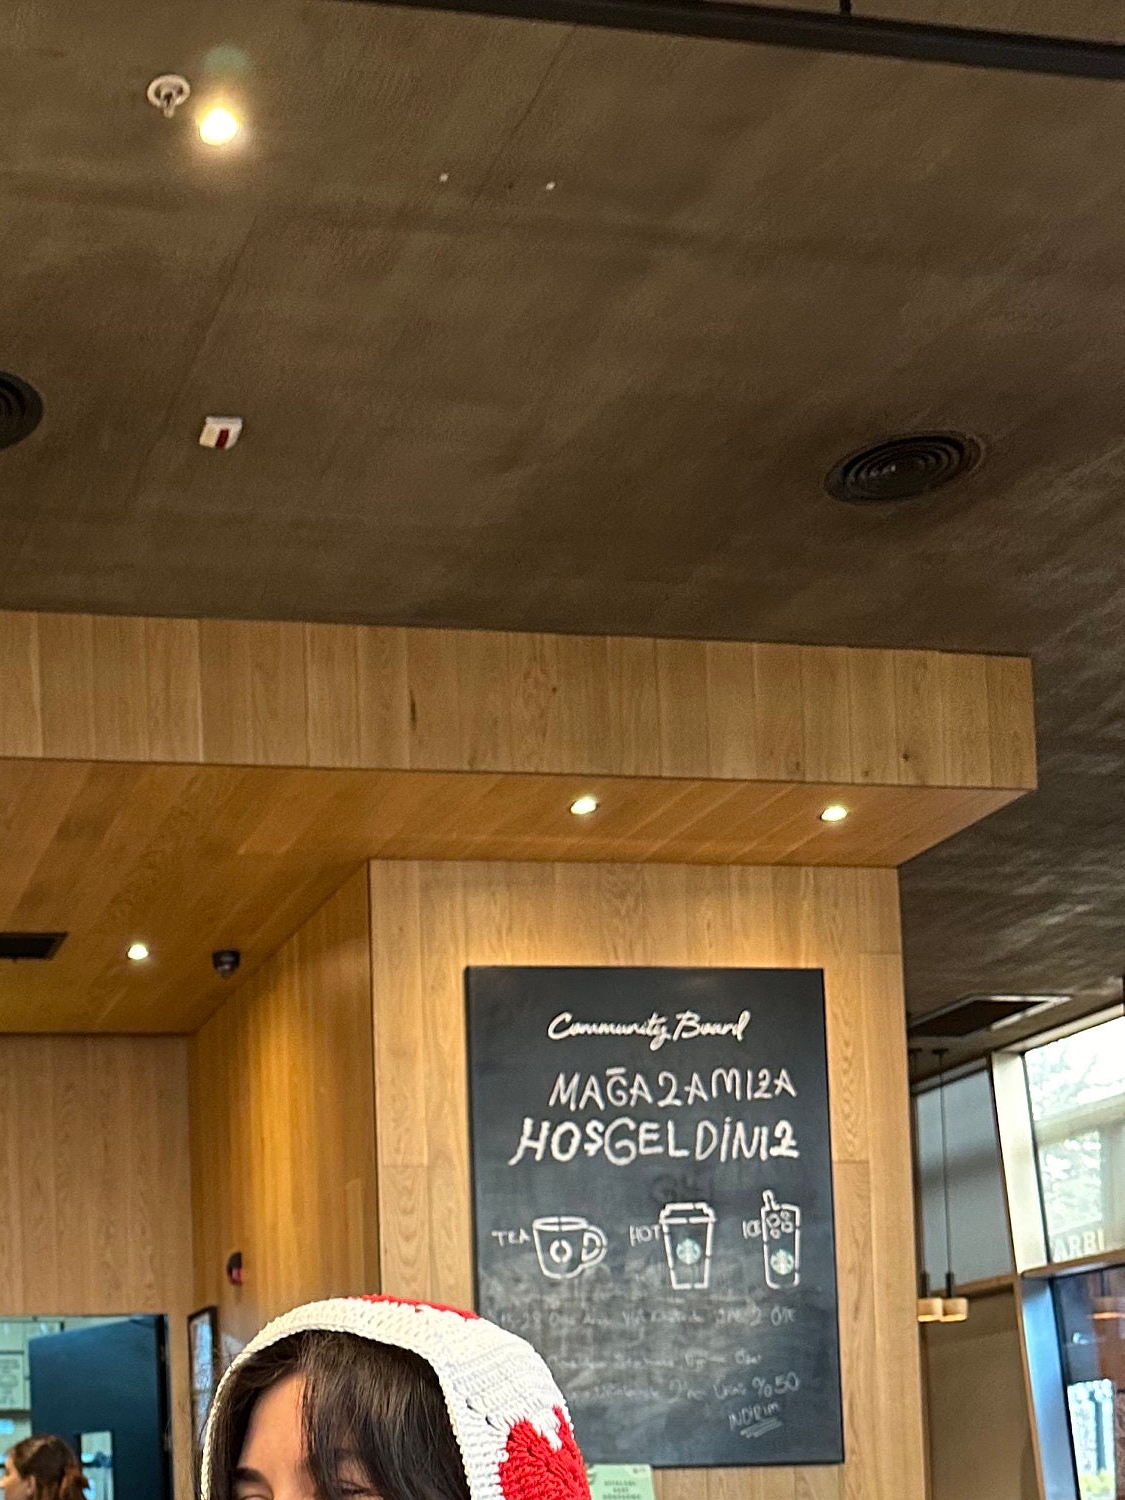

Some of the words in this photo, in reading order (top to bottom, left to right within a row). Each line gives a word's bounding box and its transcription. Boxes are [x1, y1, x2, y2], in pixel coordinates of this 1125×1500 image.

[547, 1011, 672, 1051] Community
[672, 1009, 751, 1042] Board
[491, 1227, 531, 1248] TEA
[629, 1224, 660, 1248] HOT
